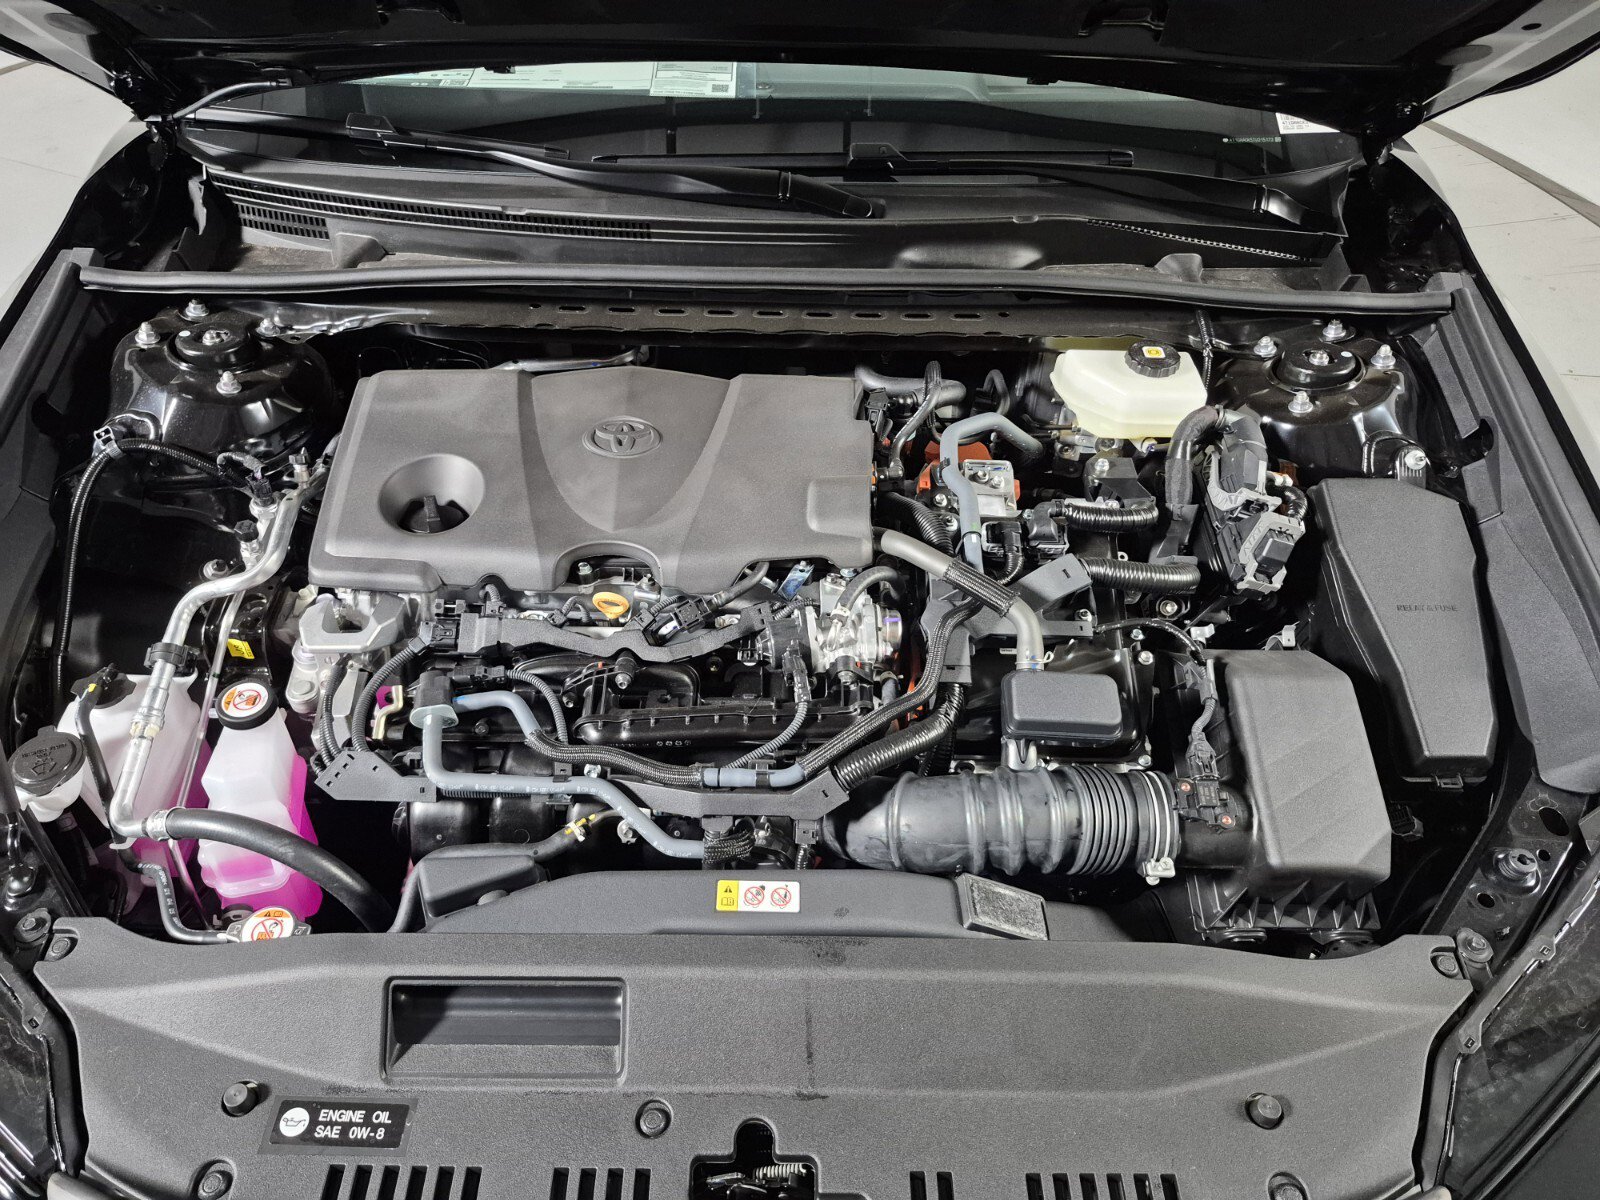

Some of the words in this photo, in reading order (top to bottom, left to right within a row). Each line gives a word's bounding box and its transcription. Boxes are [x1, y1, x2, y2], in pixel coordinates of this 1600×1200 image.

[318, 1109, 366, 1123] ENGINE
[371, 1110, 392, 1124] OIL
[314, 1125, 342, 1139] SAE
[348, 1126, 386, 1140] 0W-8
